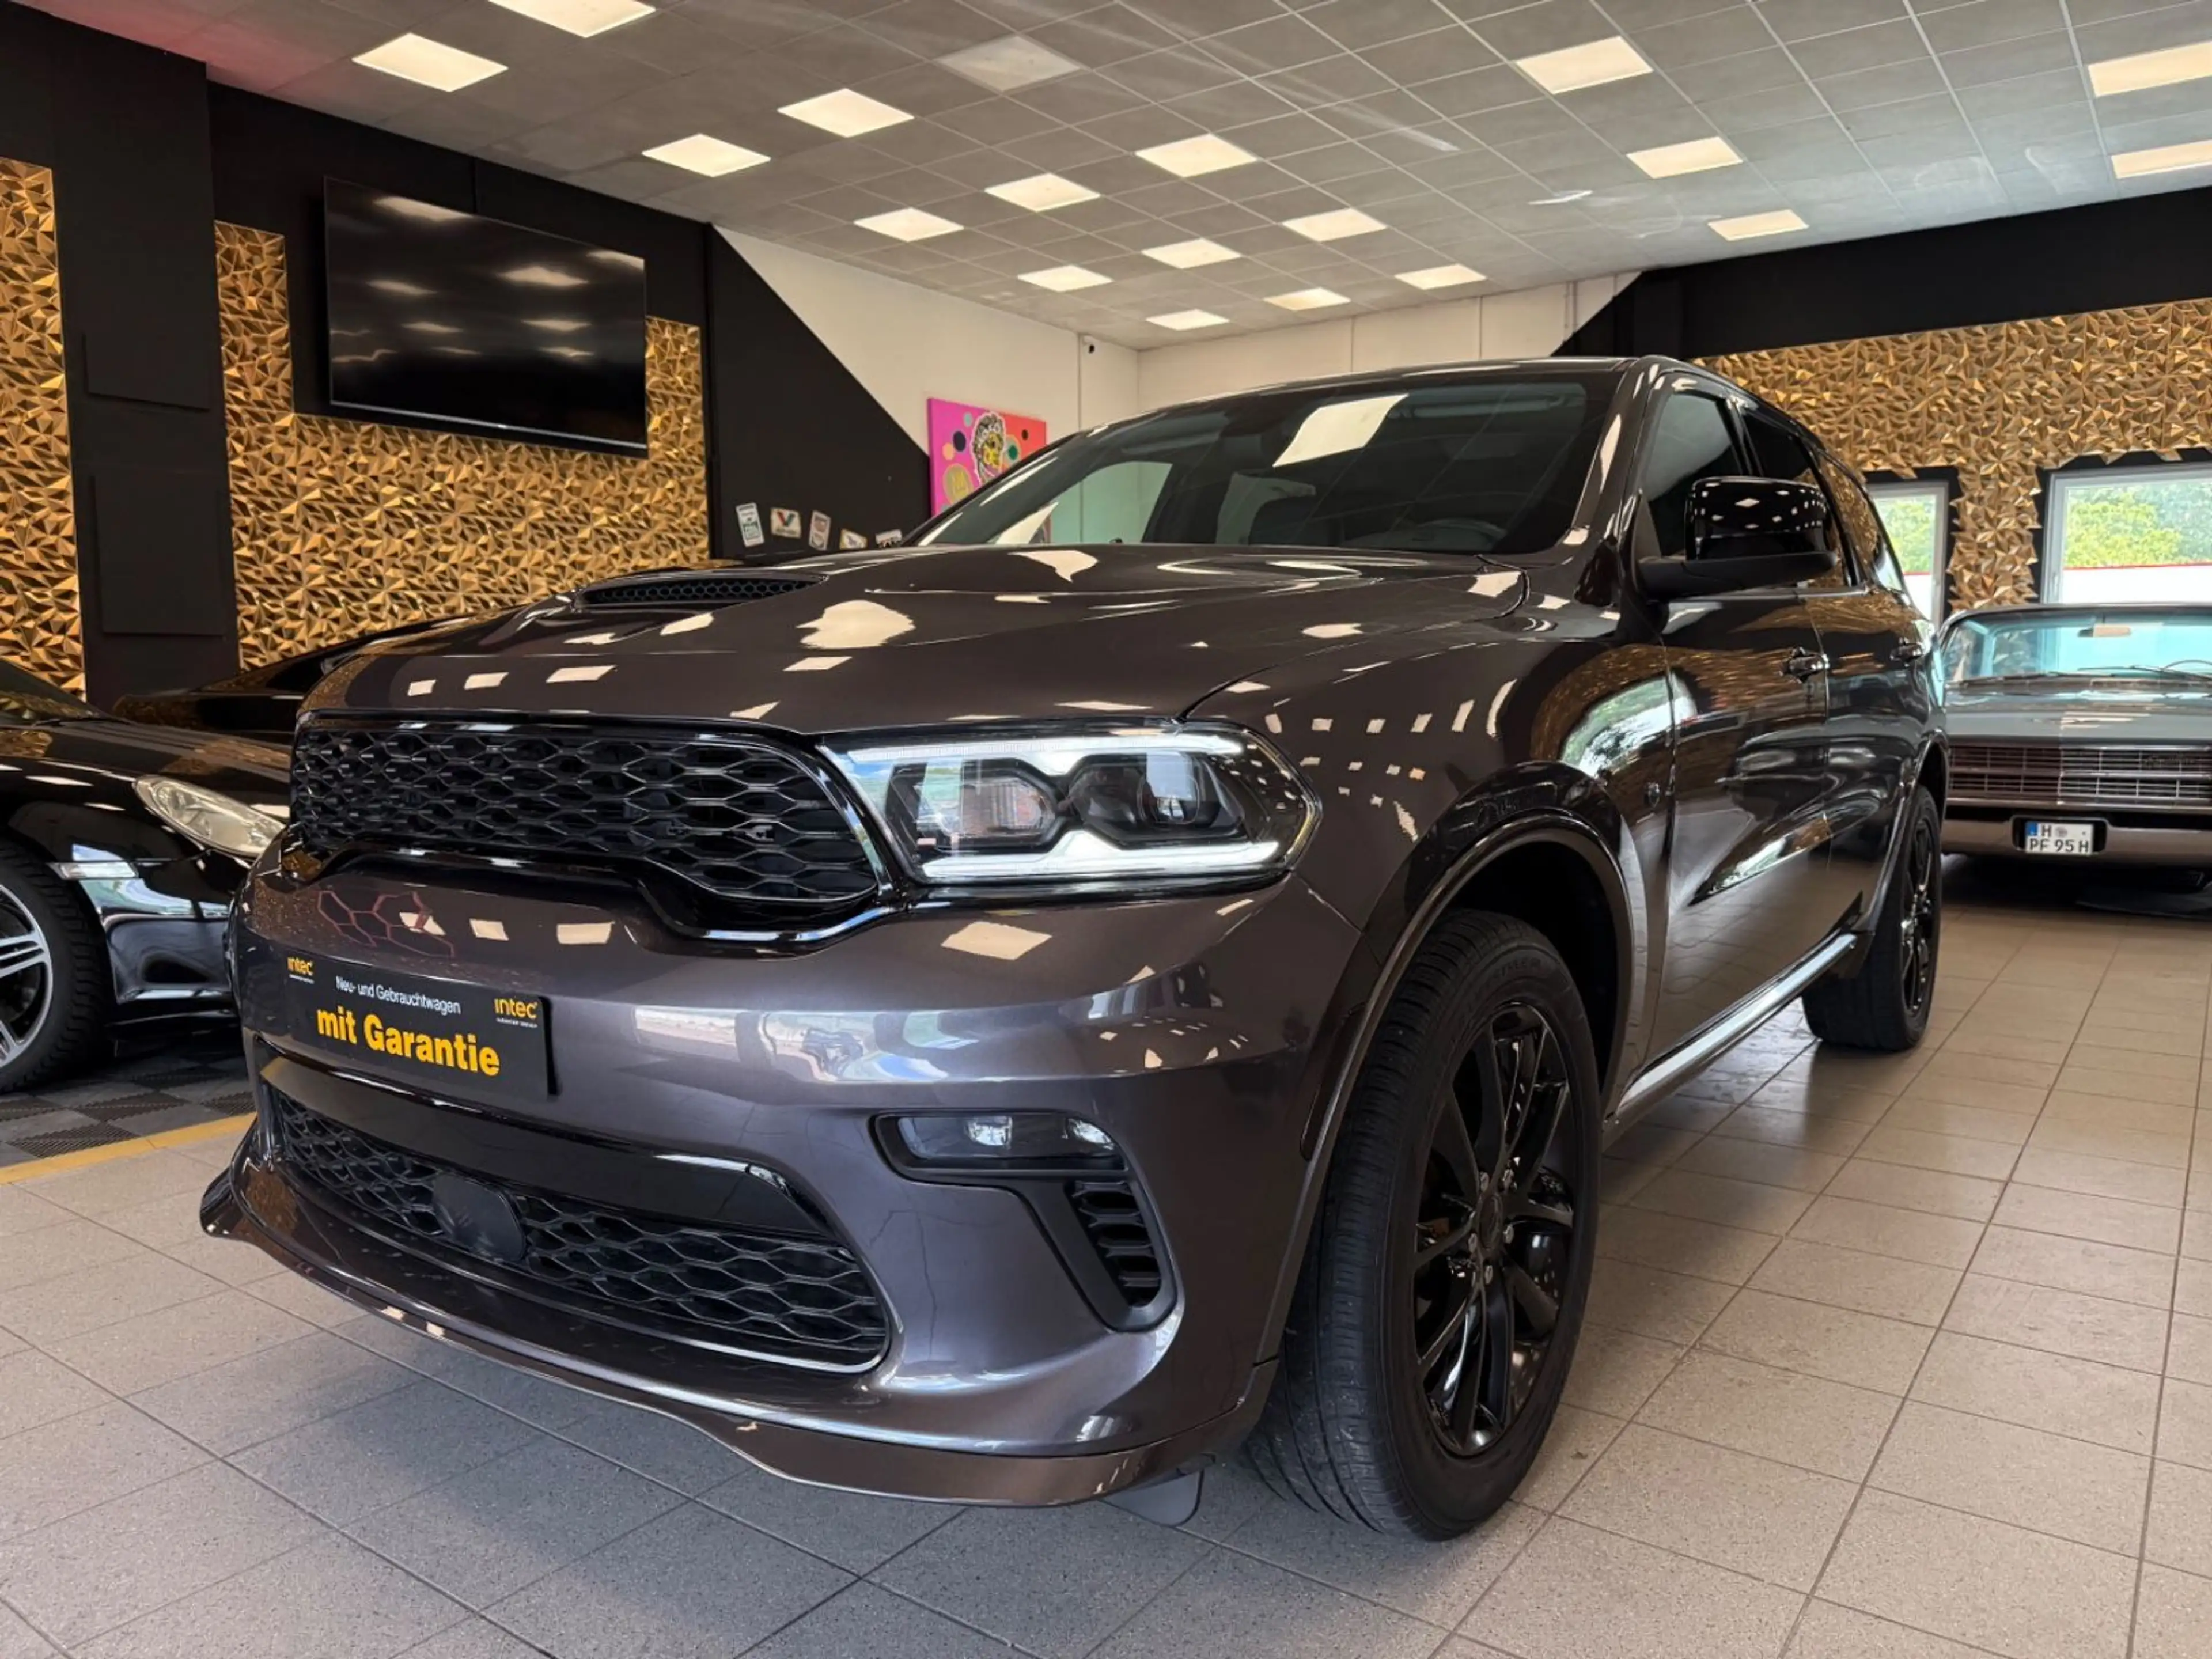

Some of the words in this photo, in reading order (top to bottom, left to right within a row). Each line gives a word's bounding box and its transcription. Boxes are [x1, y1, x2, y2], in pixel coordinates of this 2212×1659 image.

[2041, 825, 2052, 837] H
[2029, 838, 2050, 851] PF
[357, 983, 374, 998] und
[376, 984, 461, 1016] Gebrauchtwagen
[316, 1005, 358, 1045] mit
[363, 1013, 501, 1077] Garantie
